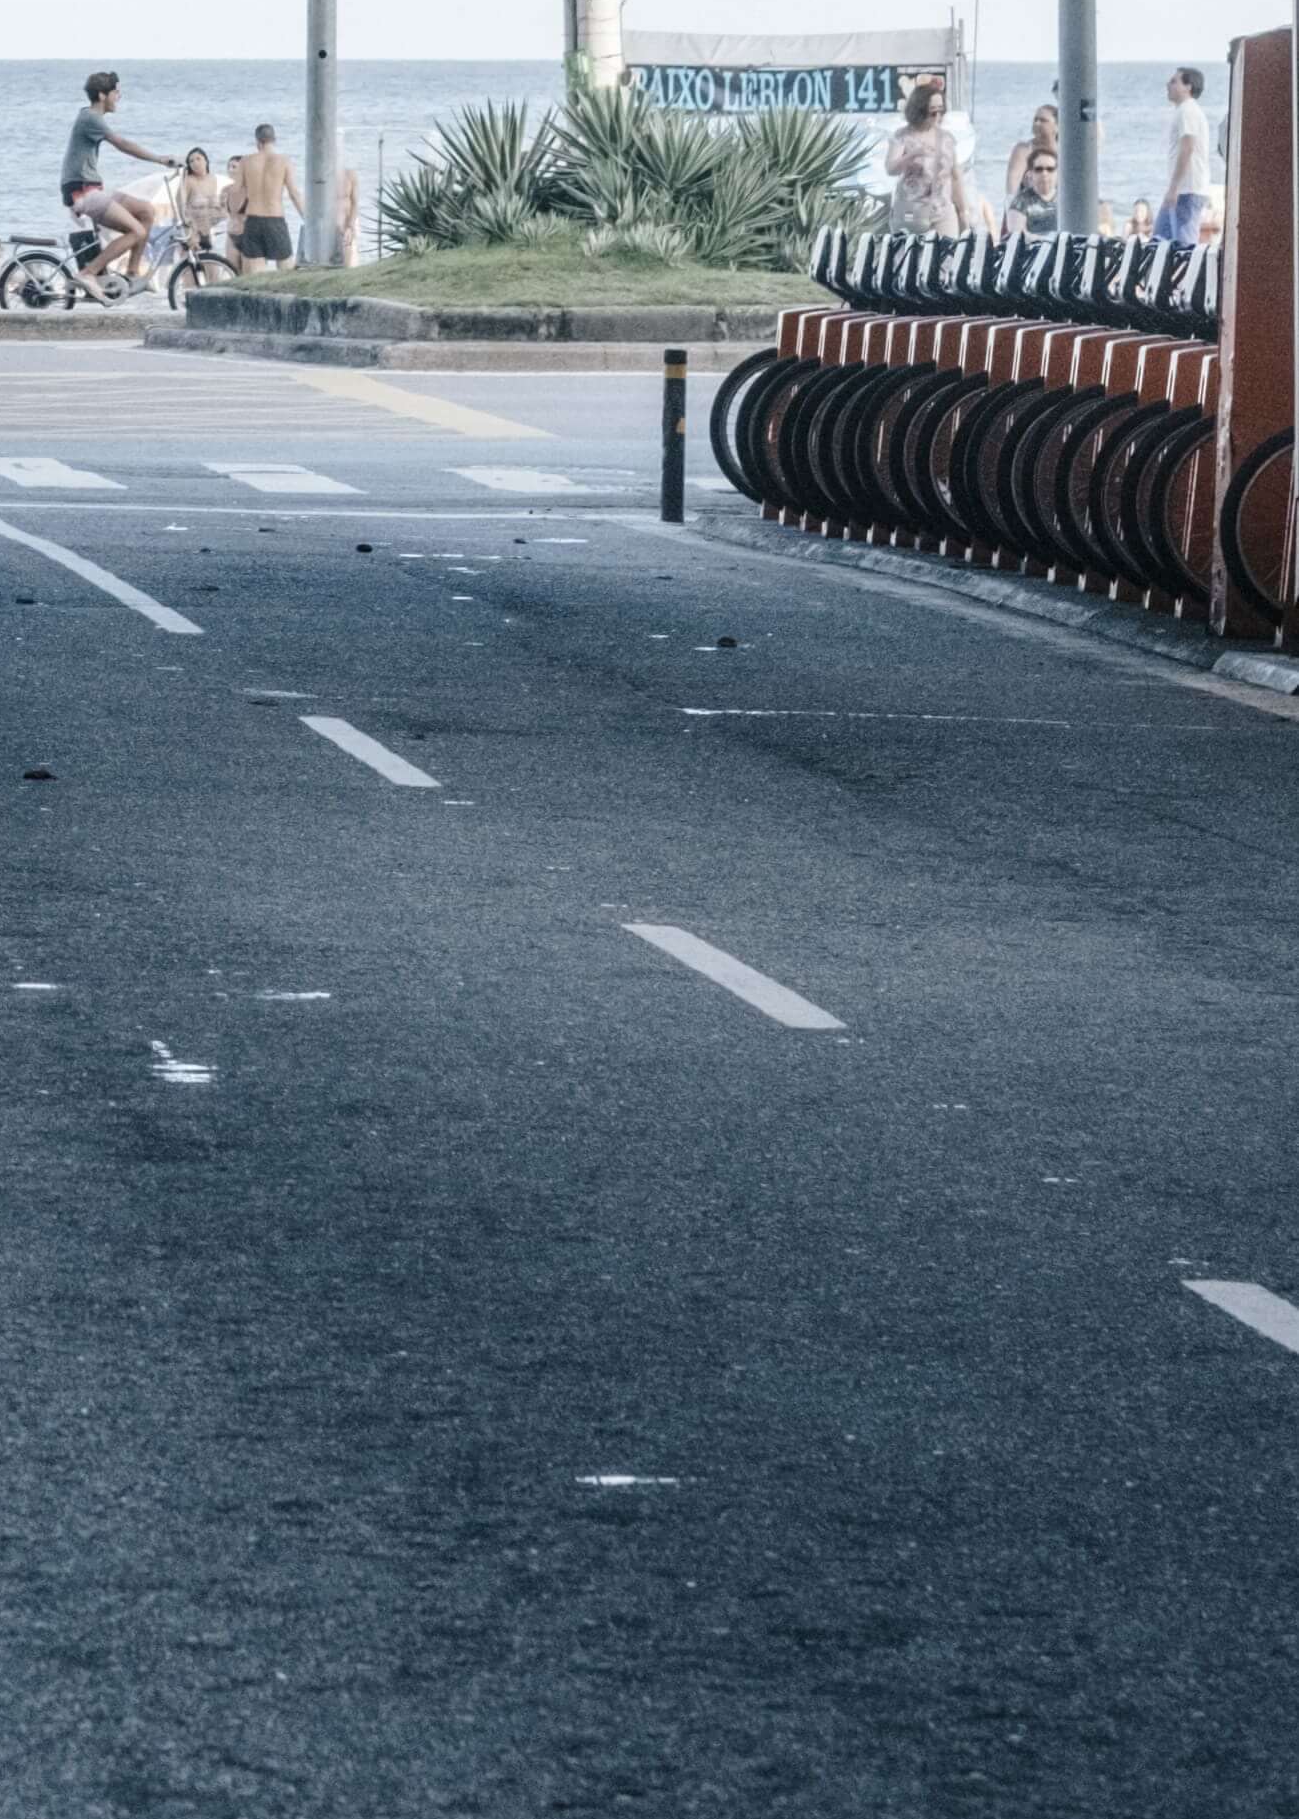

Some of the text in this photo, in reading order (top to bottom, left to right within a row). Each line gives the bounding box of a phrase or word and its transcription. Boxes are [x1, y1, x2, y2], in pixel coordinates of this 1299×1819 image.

[630, 66, 895, 112] BAIXO LEBLON 141
